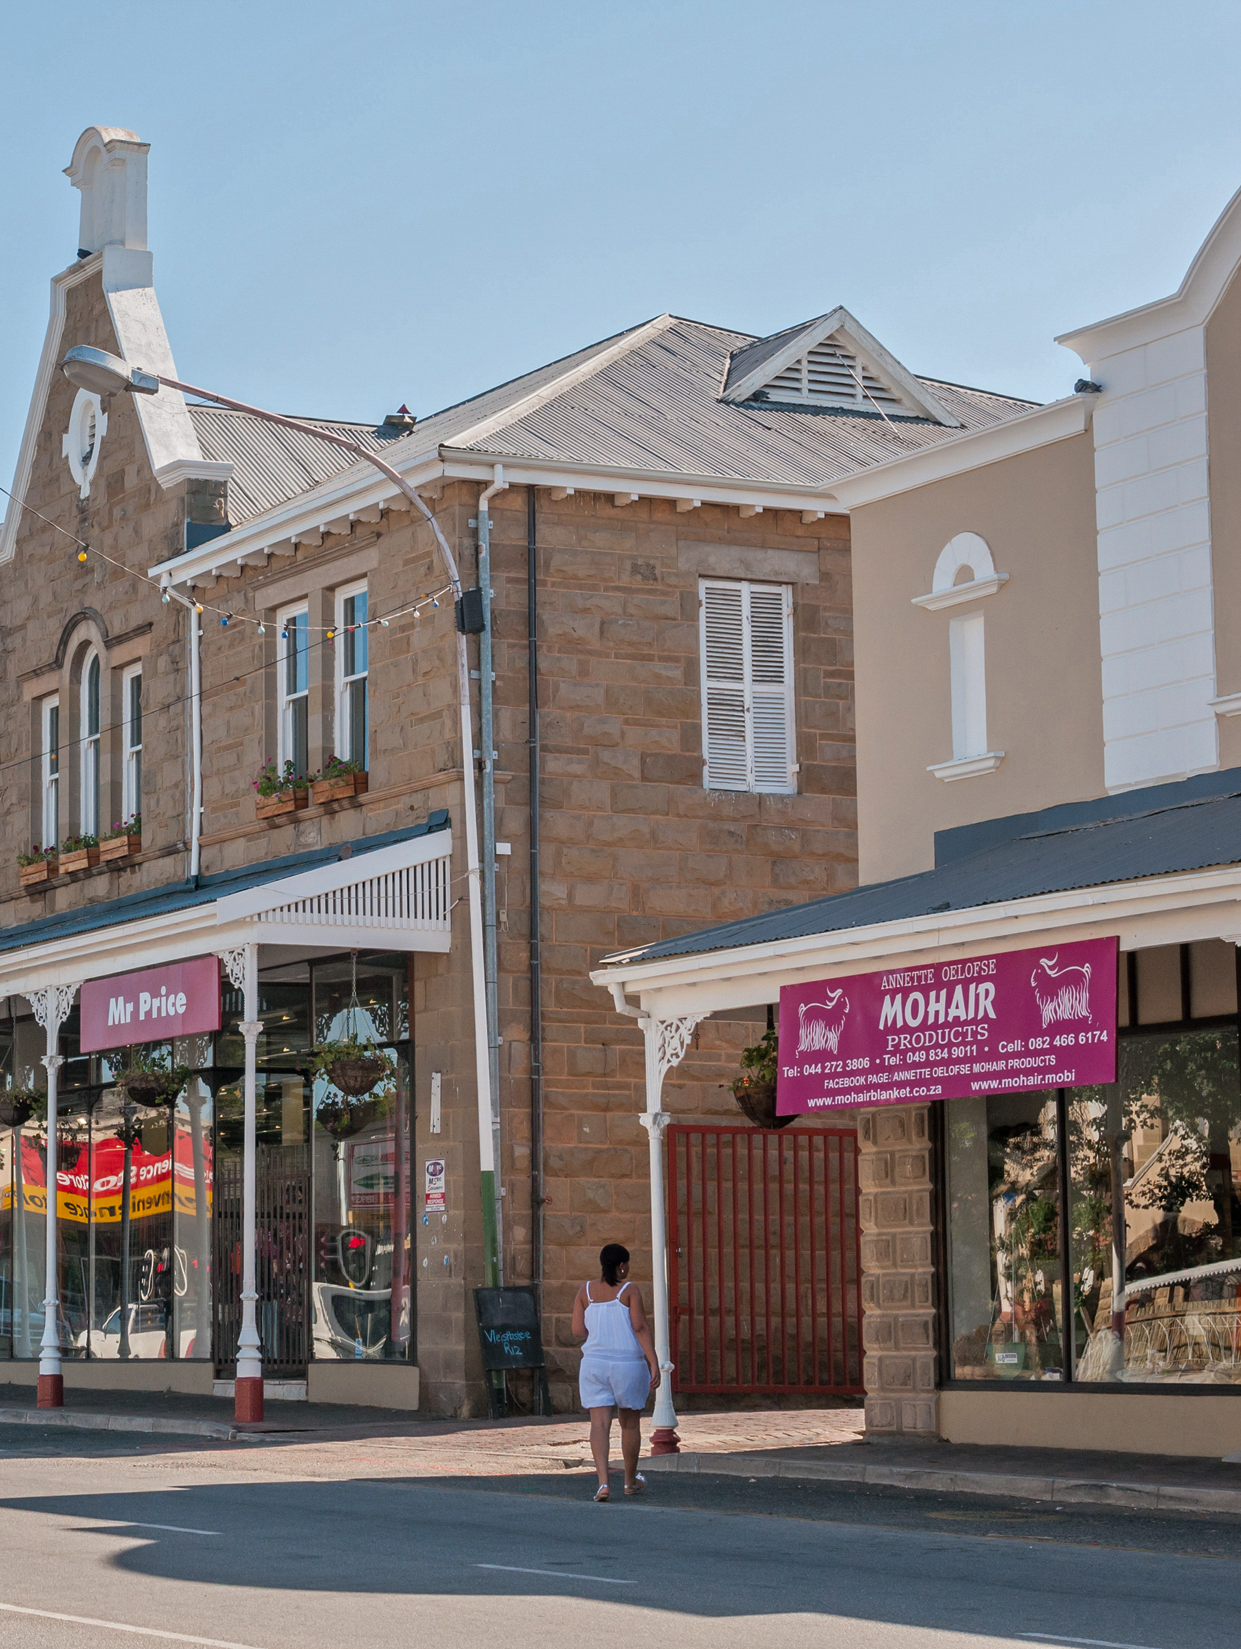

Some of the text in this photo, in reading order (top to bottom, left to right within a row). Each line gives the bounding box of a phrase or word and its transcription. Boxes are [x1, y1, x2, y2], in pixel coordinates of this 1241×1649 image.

[880, 958, 997, 990] ANNETTE OELOFSE
[107, 985, 187, 1026] Mr Price
[878, 981, 997, 1031] MOHAIR
[782, 1029, 1108, 1078] Tel: 044 272 3806 Tel: 049 834 9011 Cell: 082 466 6174
[886, 1023, 989, 1051] PRODUCTS
[807, 1069, 1076, 1108] www.mohairblanket.co.za www.mohair.mobi
[824, 1054, 1056, 1089] FACEBOOK PAGE: ANNETTE OELOFSE MOHAIR PRODUCTS
